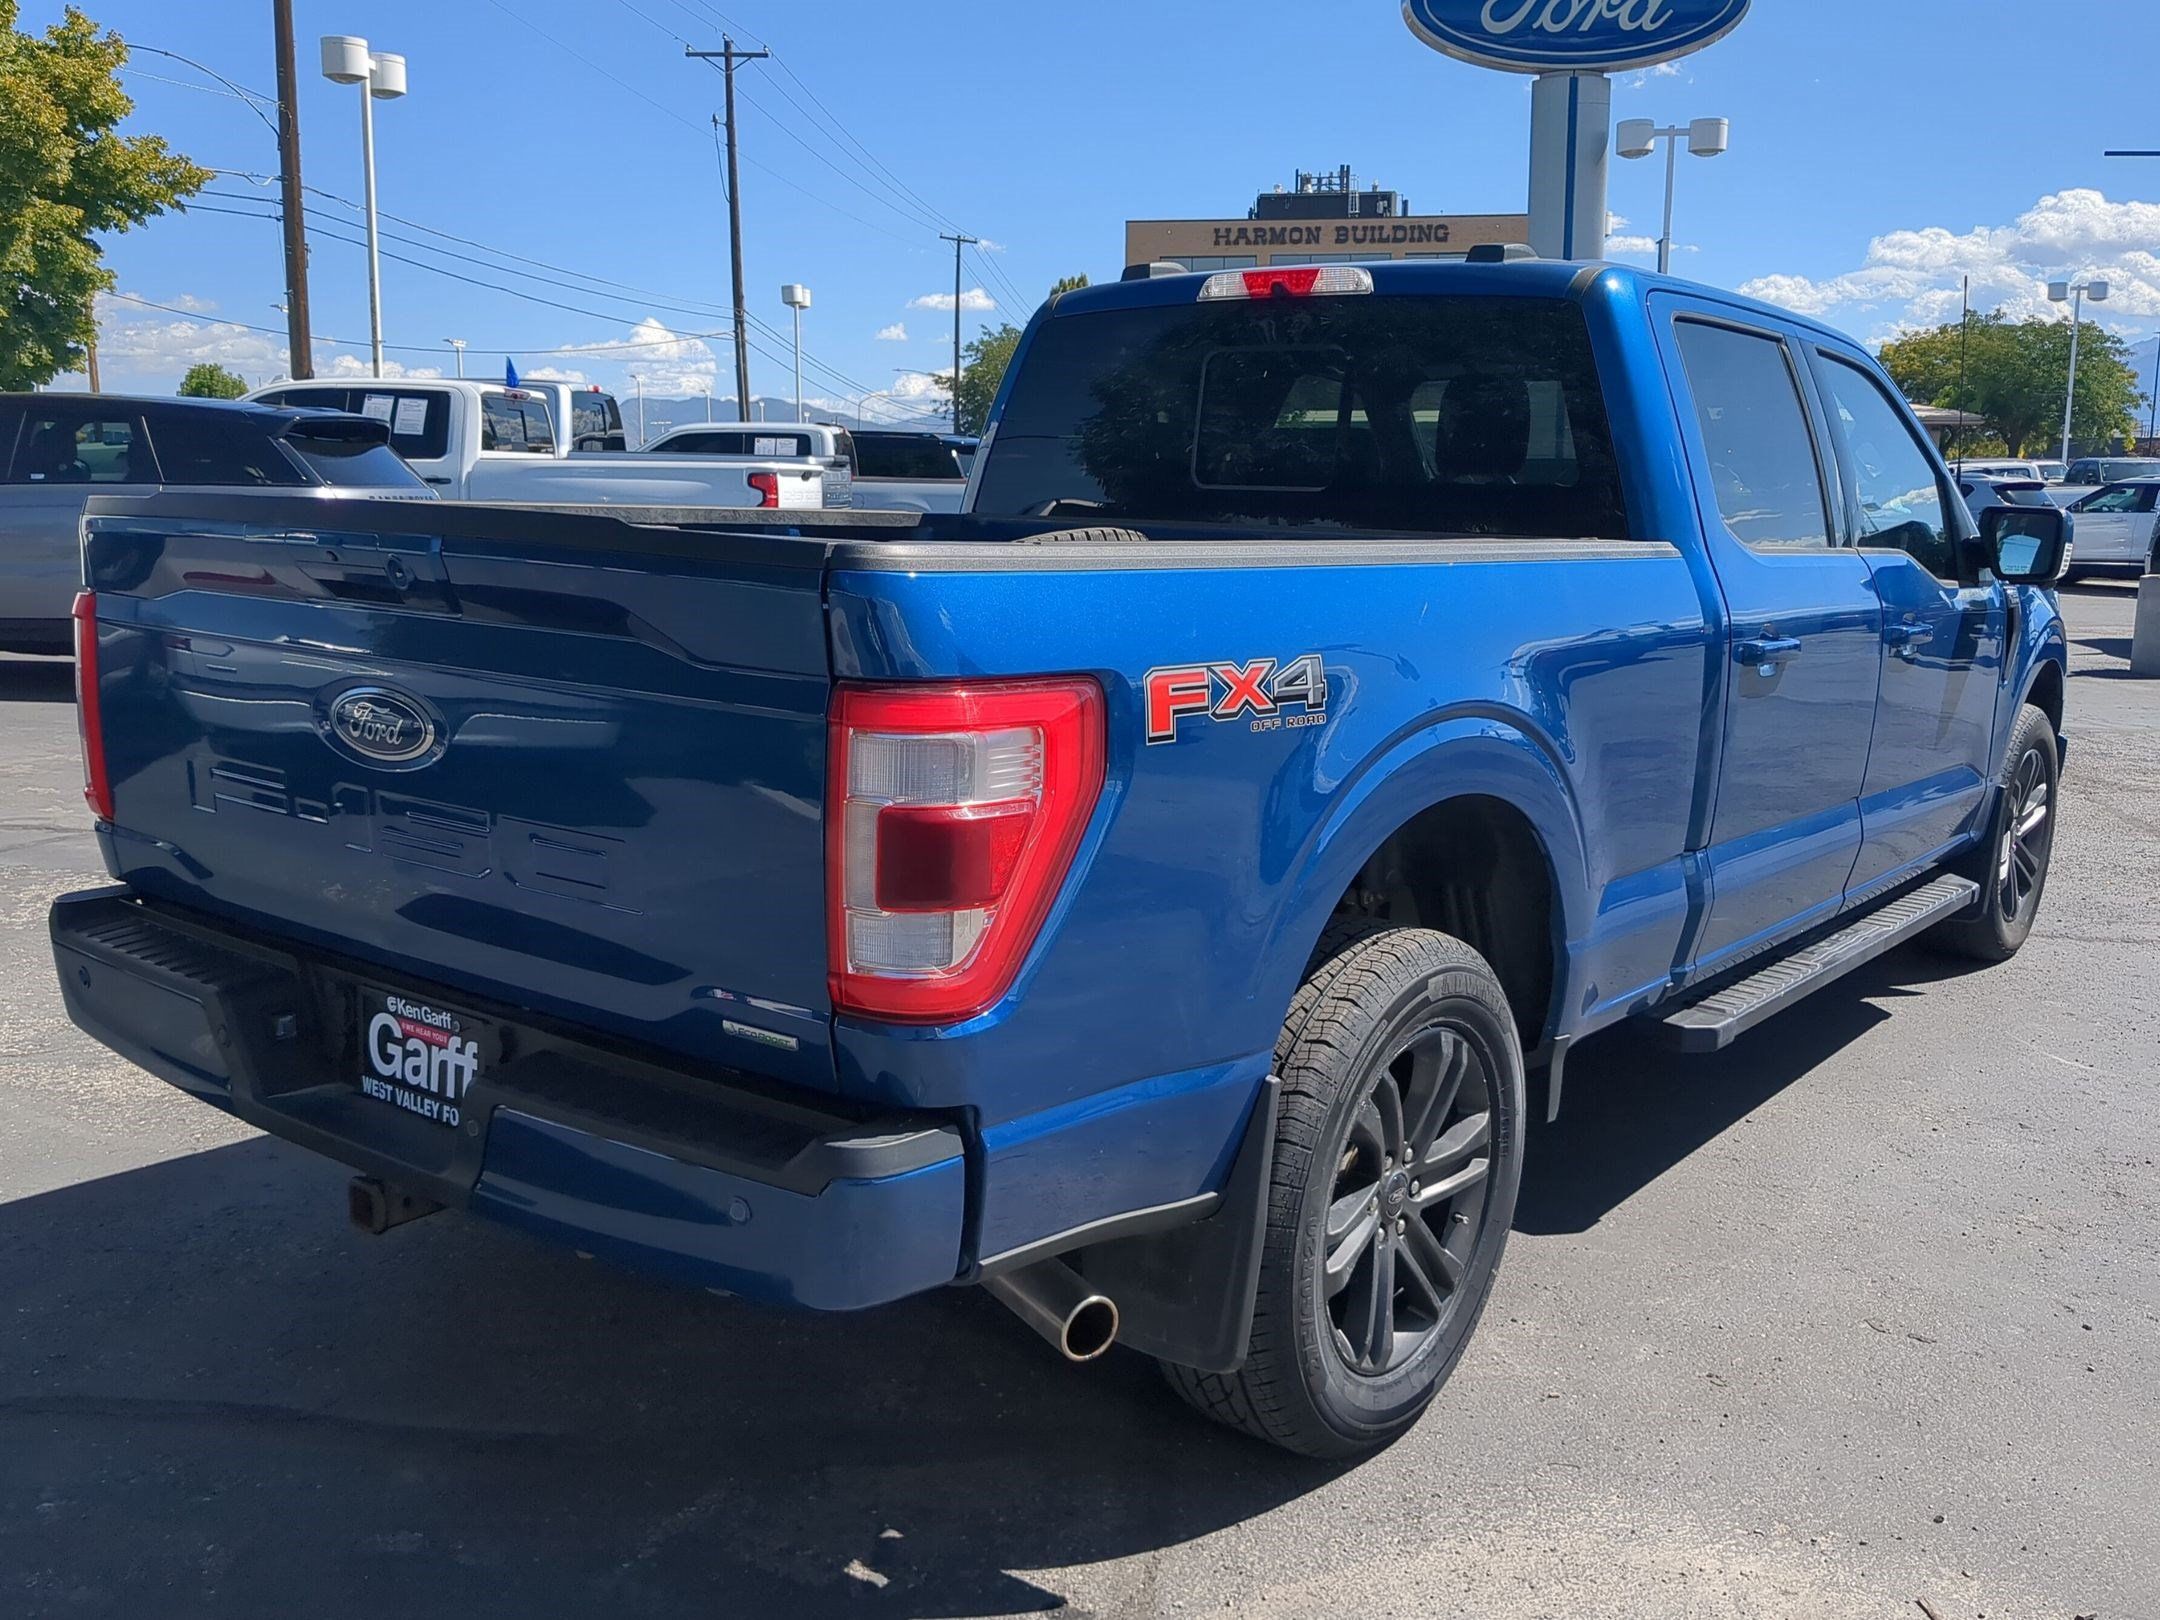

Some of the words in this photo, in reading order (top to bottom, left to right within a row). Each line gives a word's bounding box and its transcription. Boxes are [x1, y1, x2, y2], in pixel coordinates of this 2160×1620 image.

[1213, 226, 1322, 246] HARMON
[1334, 223, 1450, 245] BUILDING
[1143, 654, 1328, 746] FX4
[348, 702, 403, 745] Ford
[1250, 717, 1283, 733] OFF
[1286, 713, 1327, 729] ROAD
[368, 1012, 478, 1099] Garff
[362, 1075, 393, 1102] WEST
[396, 1087, 440, 1120] VALLEY
